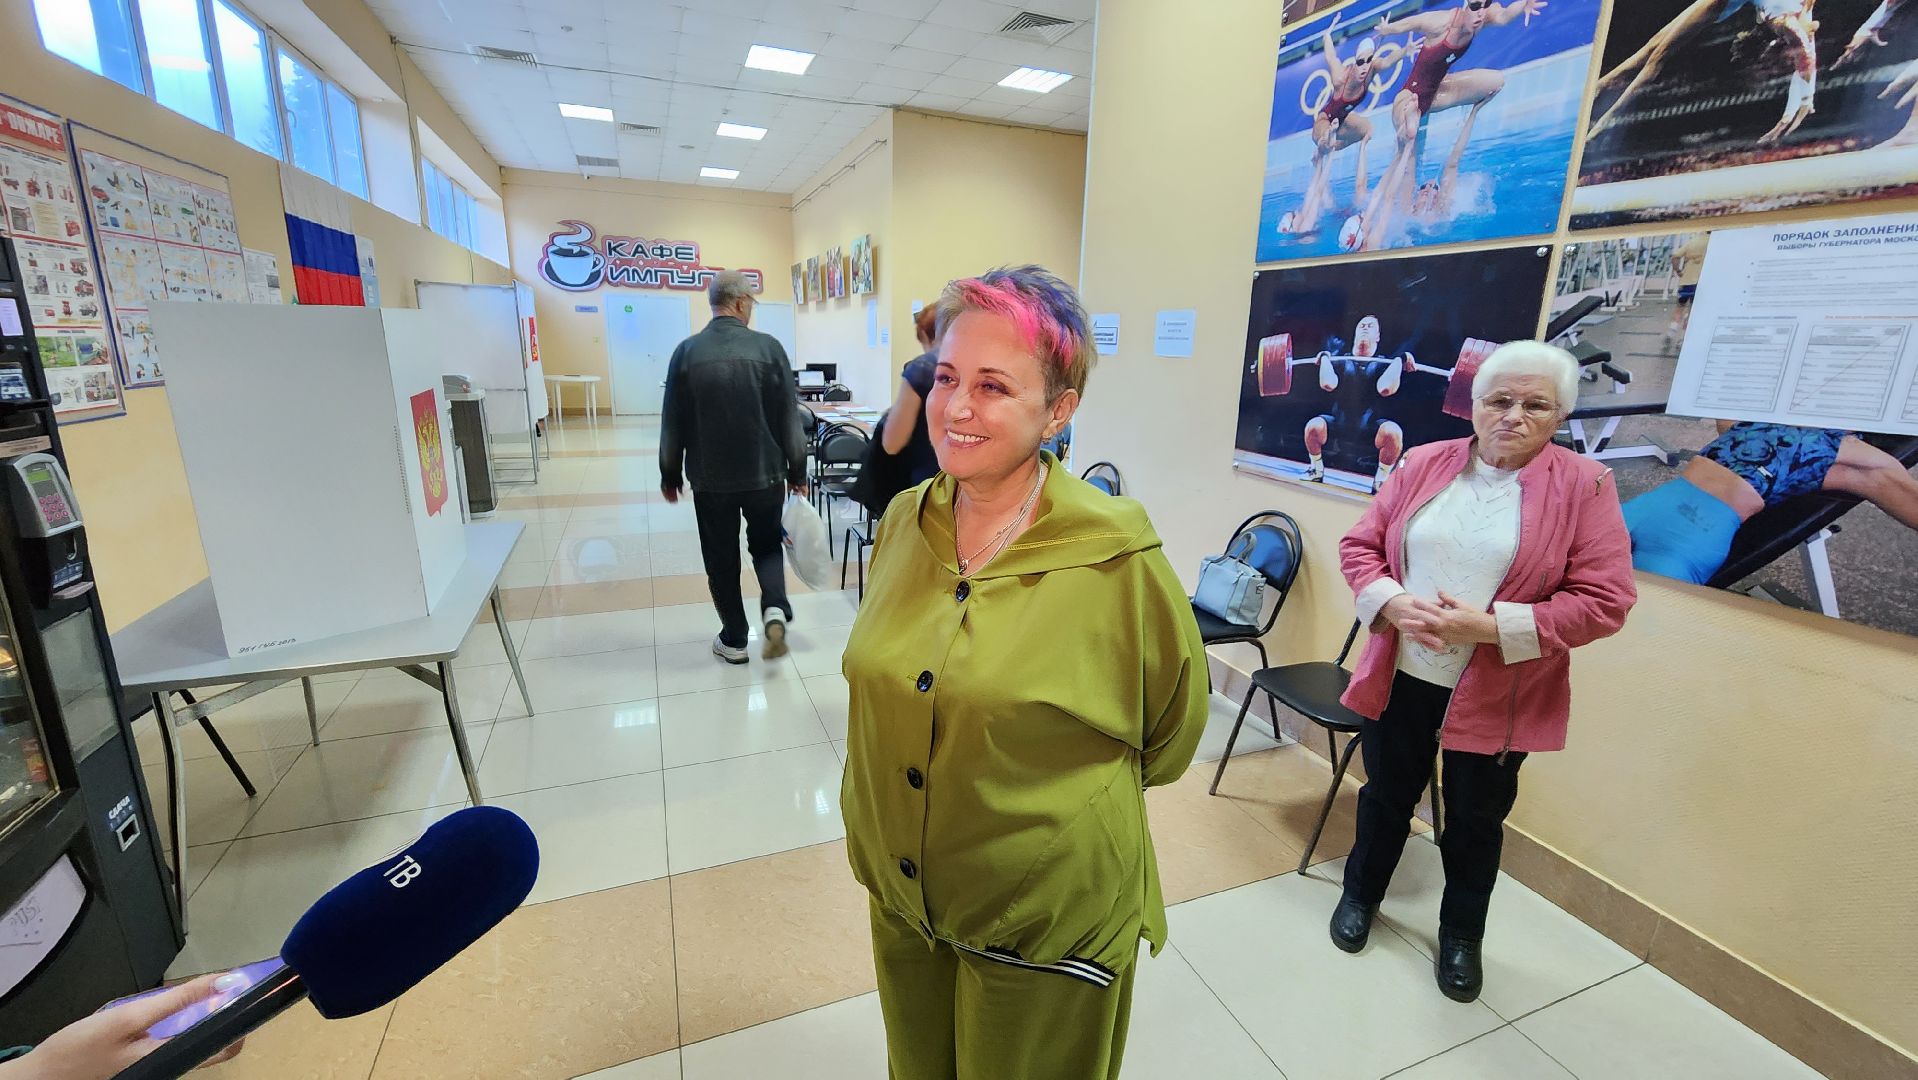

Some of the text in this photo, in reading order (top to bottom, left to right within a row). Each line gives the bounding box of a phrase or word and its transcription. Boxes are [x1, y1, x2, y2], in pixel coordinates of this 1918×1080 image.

[1772, 223, 1918, 242] ПОРЯДОК ЗАПОЛНЕНИ
[606, 240, 696, 261] КАФЕ
[1777, 242, 1817, 250] ВЫБОРЫ
[1819, 237, 1882, 247] ГУБЕРНАТОРА
[608, 265, 758, 289] ИМПУЛ
[383, 854, 422, 888] ТВ
